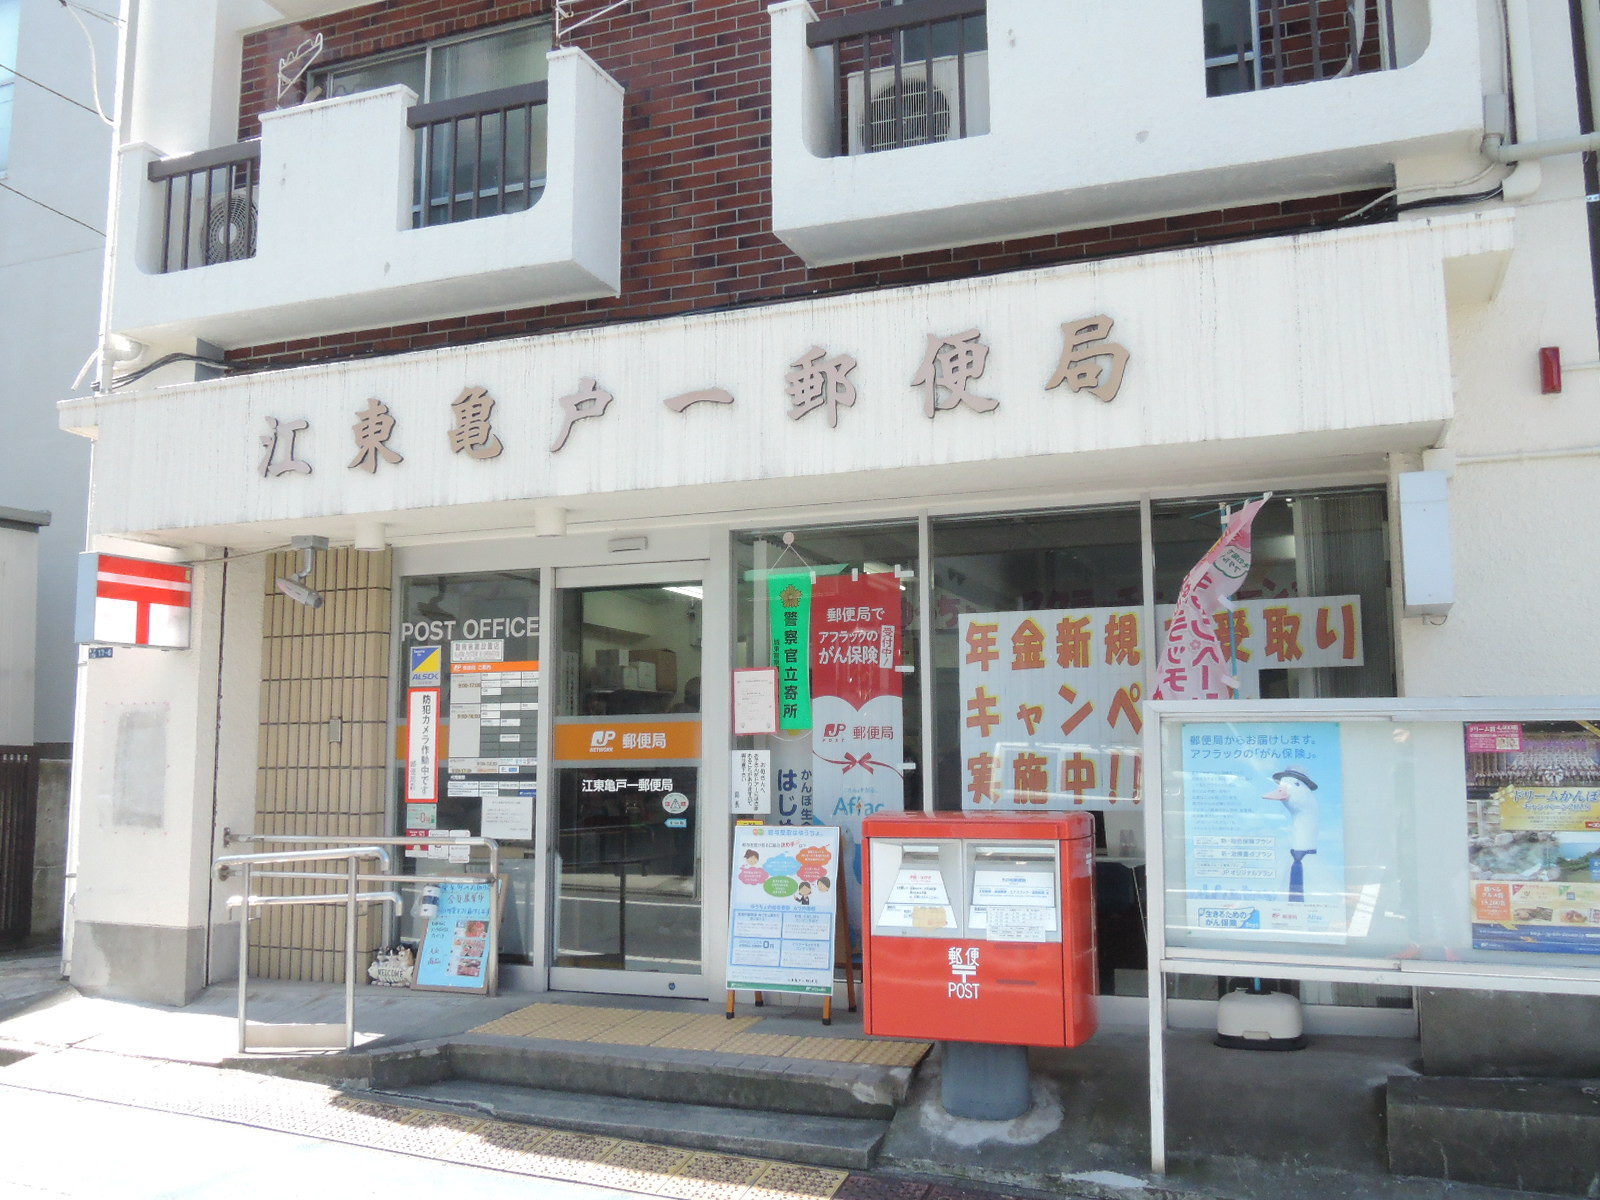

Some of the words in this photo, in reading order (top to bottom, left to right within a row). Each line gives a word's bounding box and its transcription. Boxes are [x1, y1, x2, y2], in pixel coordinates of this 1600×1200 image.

[259, 313, 1131, 479] 江東亀戸一郵便局
[827, 606, 885, 622] 郵便局で
[401, 620, 456, 641] POST
[463, 616, 539, 640] OFFICE
[819, 630, 879, 643] アフラックの
[965, 603, 1359, 672] 年金新規受取り
[818, 646, 879, 665] がん保険
[783, 611, 799, 719] 警察官立寄所
[412, 672, 440, 680] ALSOK
[622, 732, 667, 750] 郵便局
[852, 725, 894, 741] 郵便局
[1189, 735, 1316, 747] 郵便局からお届けします。
[421, 694, 431, 795] 防犯カメラ作動中です
[1190, 748, 1317, 760] アフラックの「がん保険」。
[582, 778, 674, 793] 江東亀戸一郵便局
[777, 769, 798, 826] はじ
[1205, 909, 1247, 919] 生きるための
[947, 947, 980, 967] 郵便
[378, 968, 404, 978] WELCOME
[948, 982, 980, 999] POST
